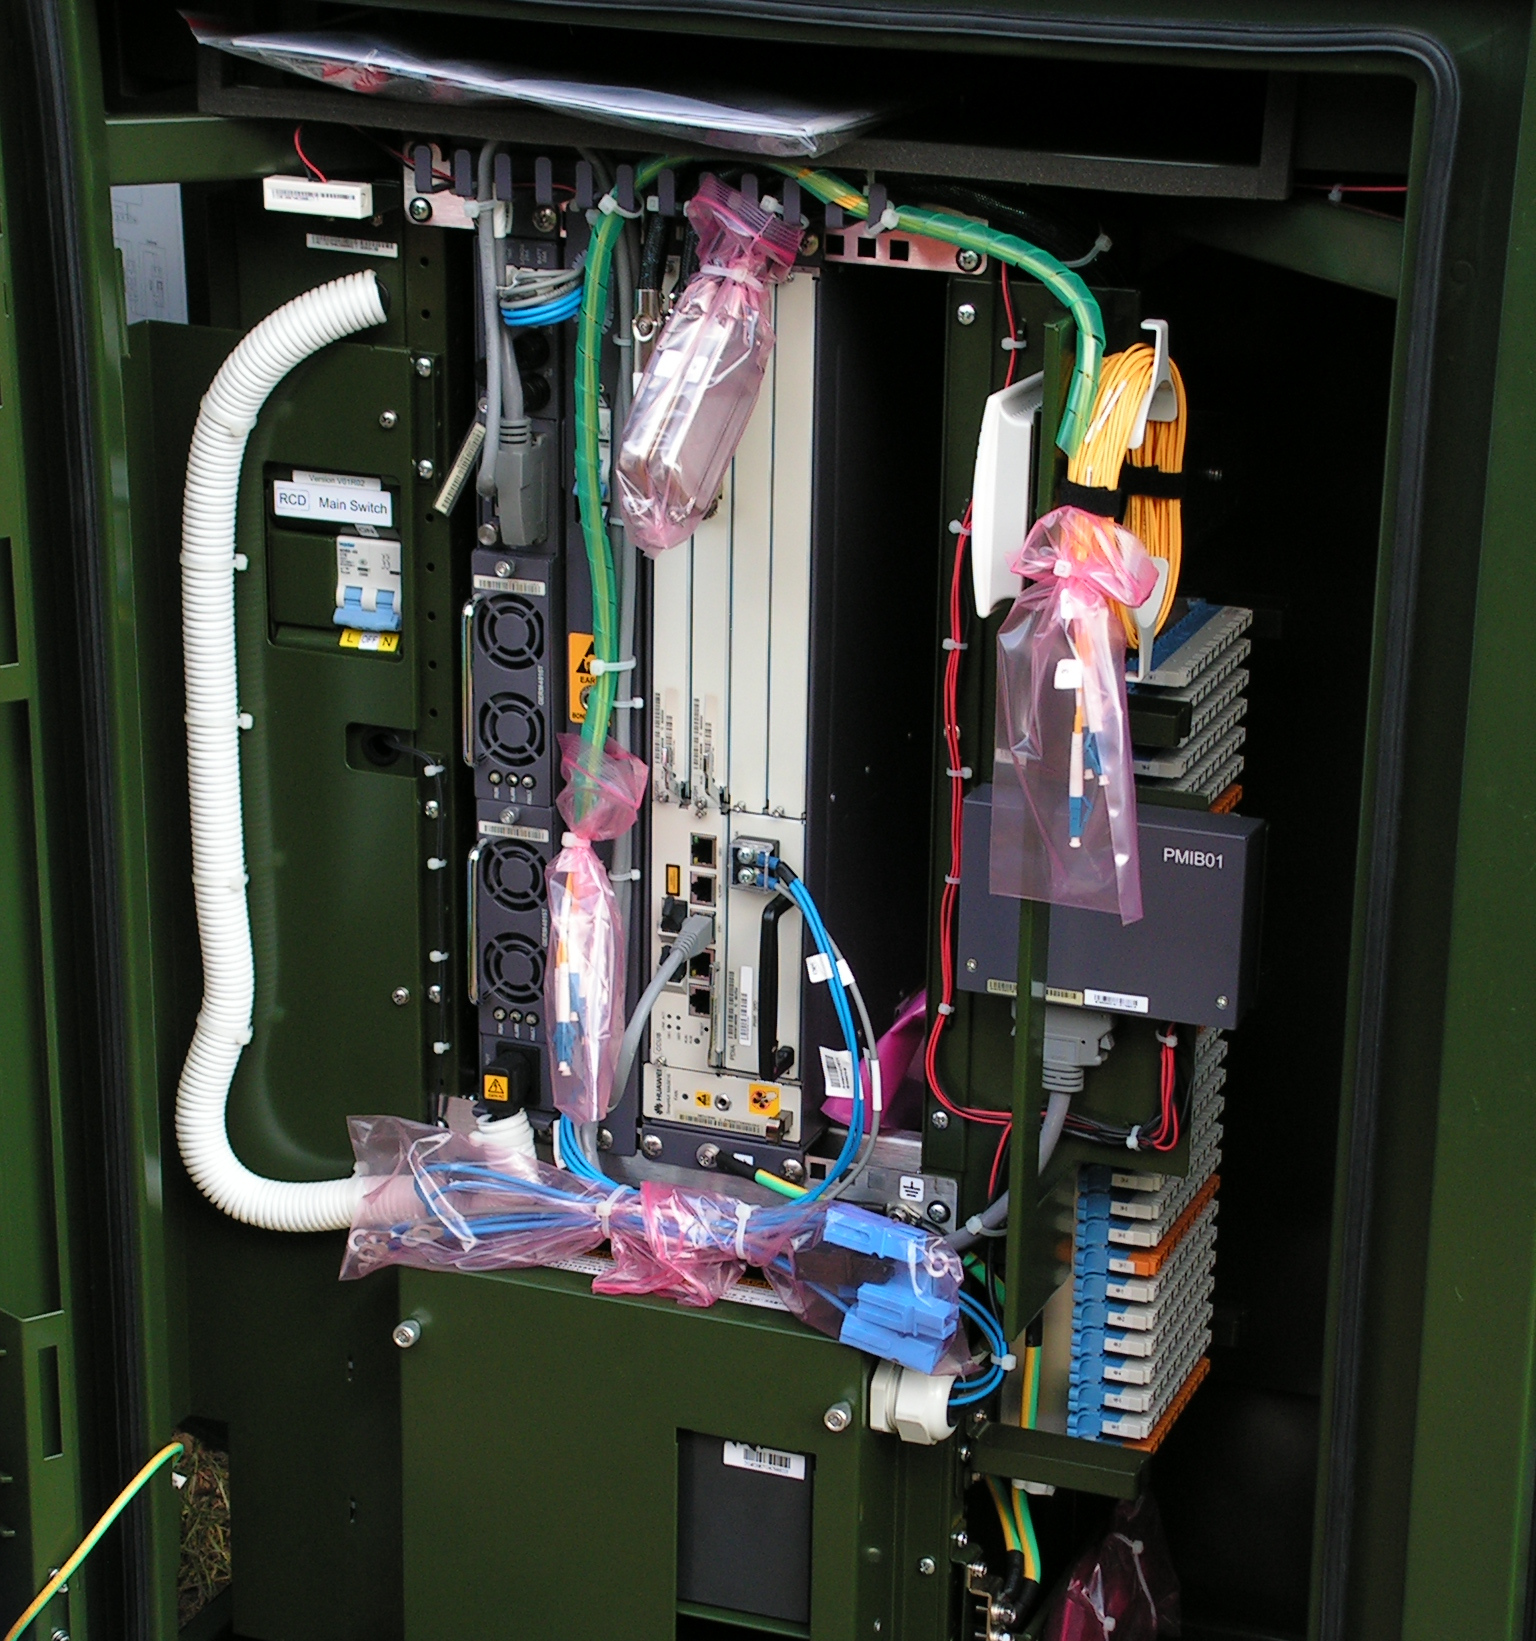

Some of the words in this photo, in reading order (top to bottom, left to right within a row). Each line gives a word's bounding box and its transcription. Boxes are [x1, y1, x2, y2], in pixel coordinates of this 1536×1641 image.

[308, 475, 337, 485] Version
[279, 492, 307, 506] RCD
[318, 497, 347, 511] Main
[350, 500, 388, 515] Switch
[359, 527, 375, 535] ON
[346, 632, 353, 643] L
[361, 633, 379, 644] OFF
[382, 635, 393, 647] N
[580, 676, 596, 684] EAR
[1163, 847, 1223, 870] PMIB01
